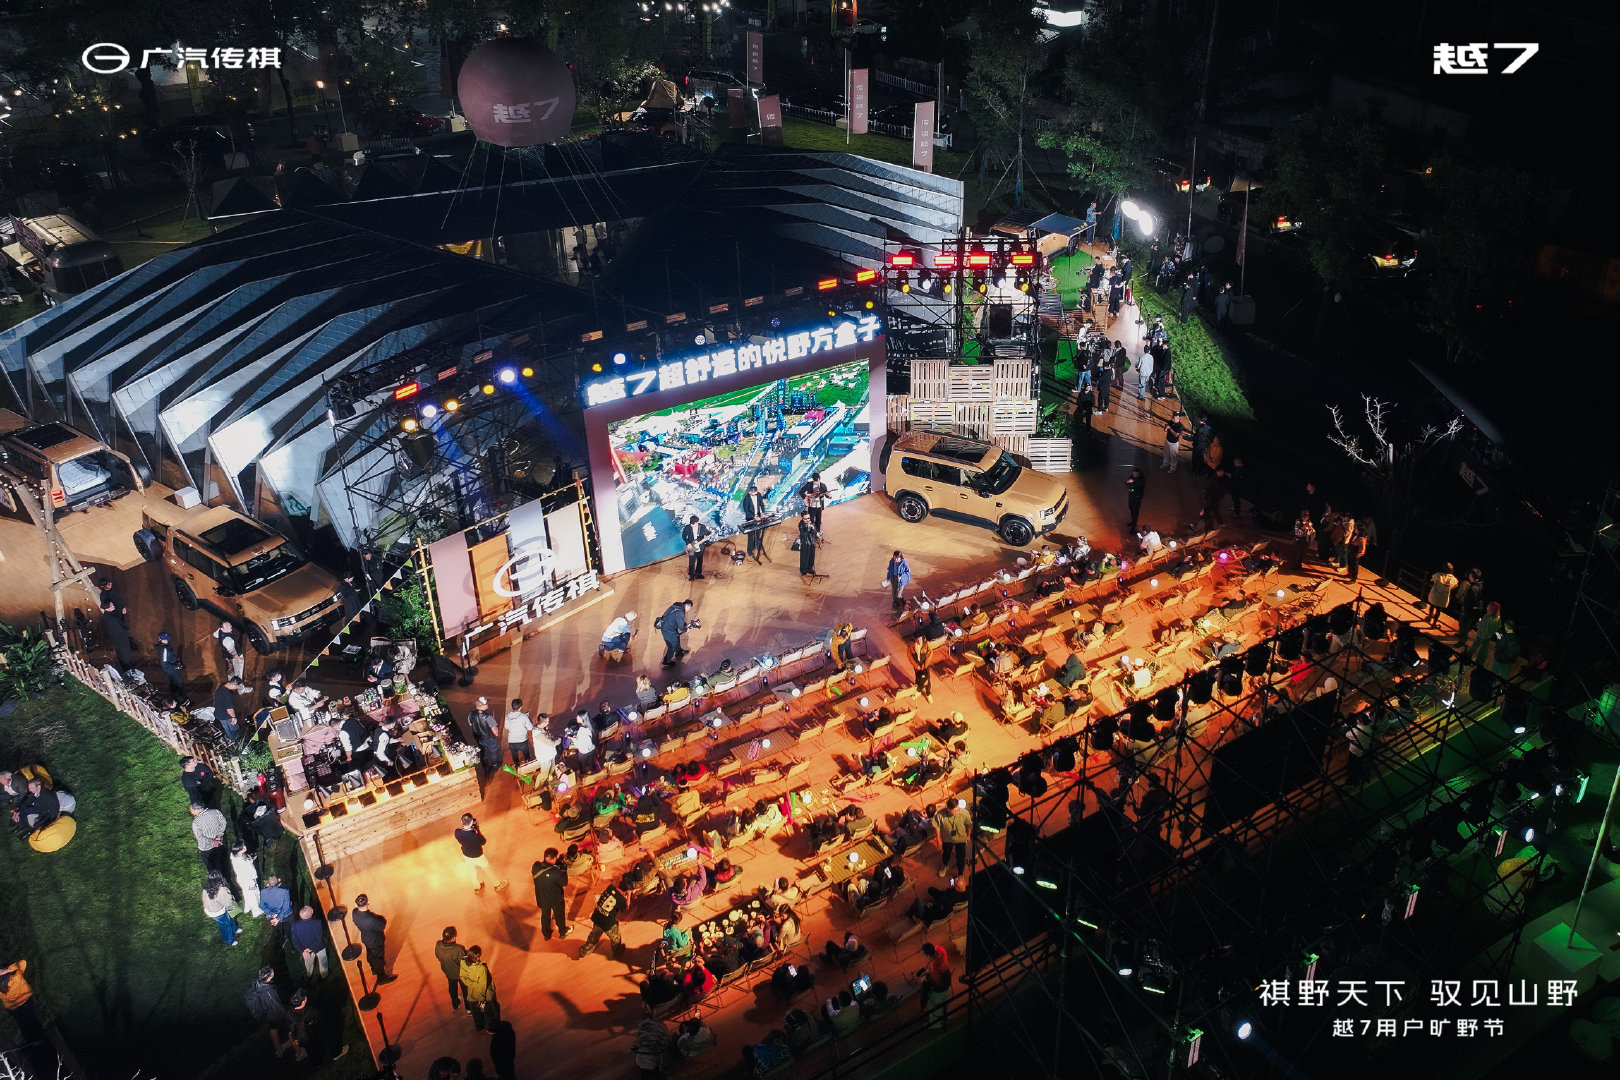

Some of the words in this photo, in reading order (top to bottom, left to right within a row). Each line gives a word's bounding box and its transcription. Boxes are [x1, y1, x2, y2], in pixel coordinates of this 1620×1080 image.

[493, 97, 559, 123] 越7
[462, 570, 600, 657] 广汽传祺
